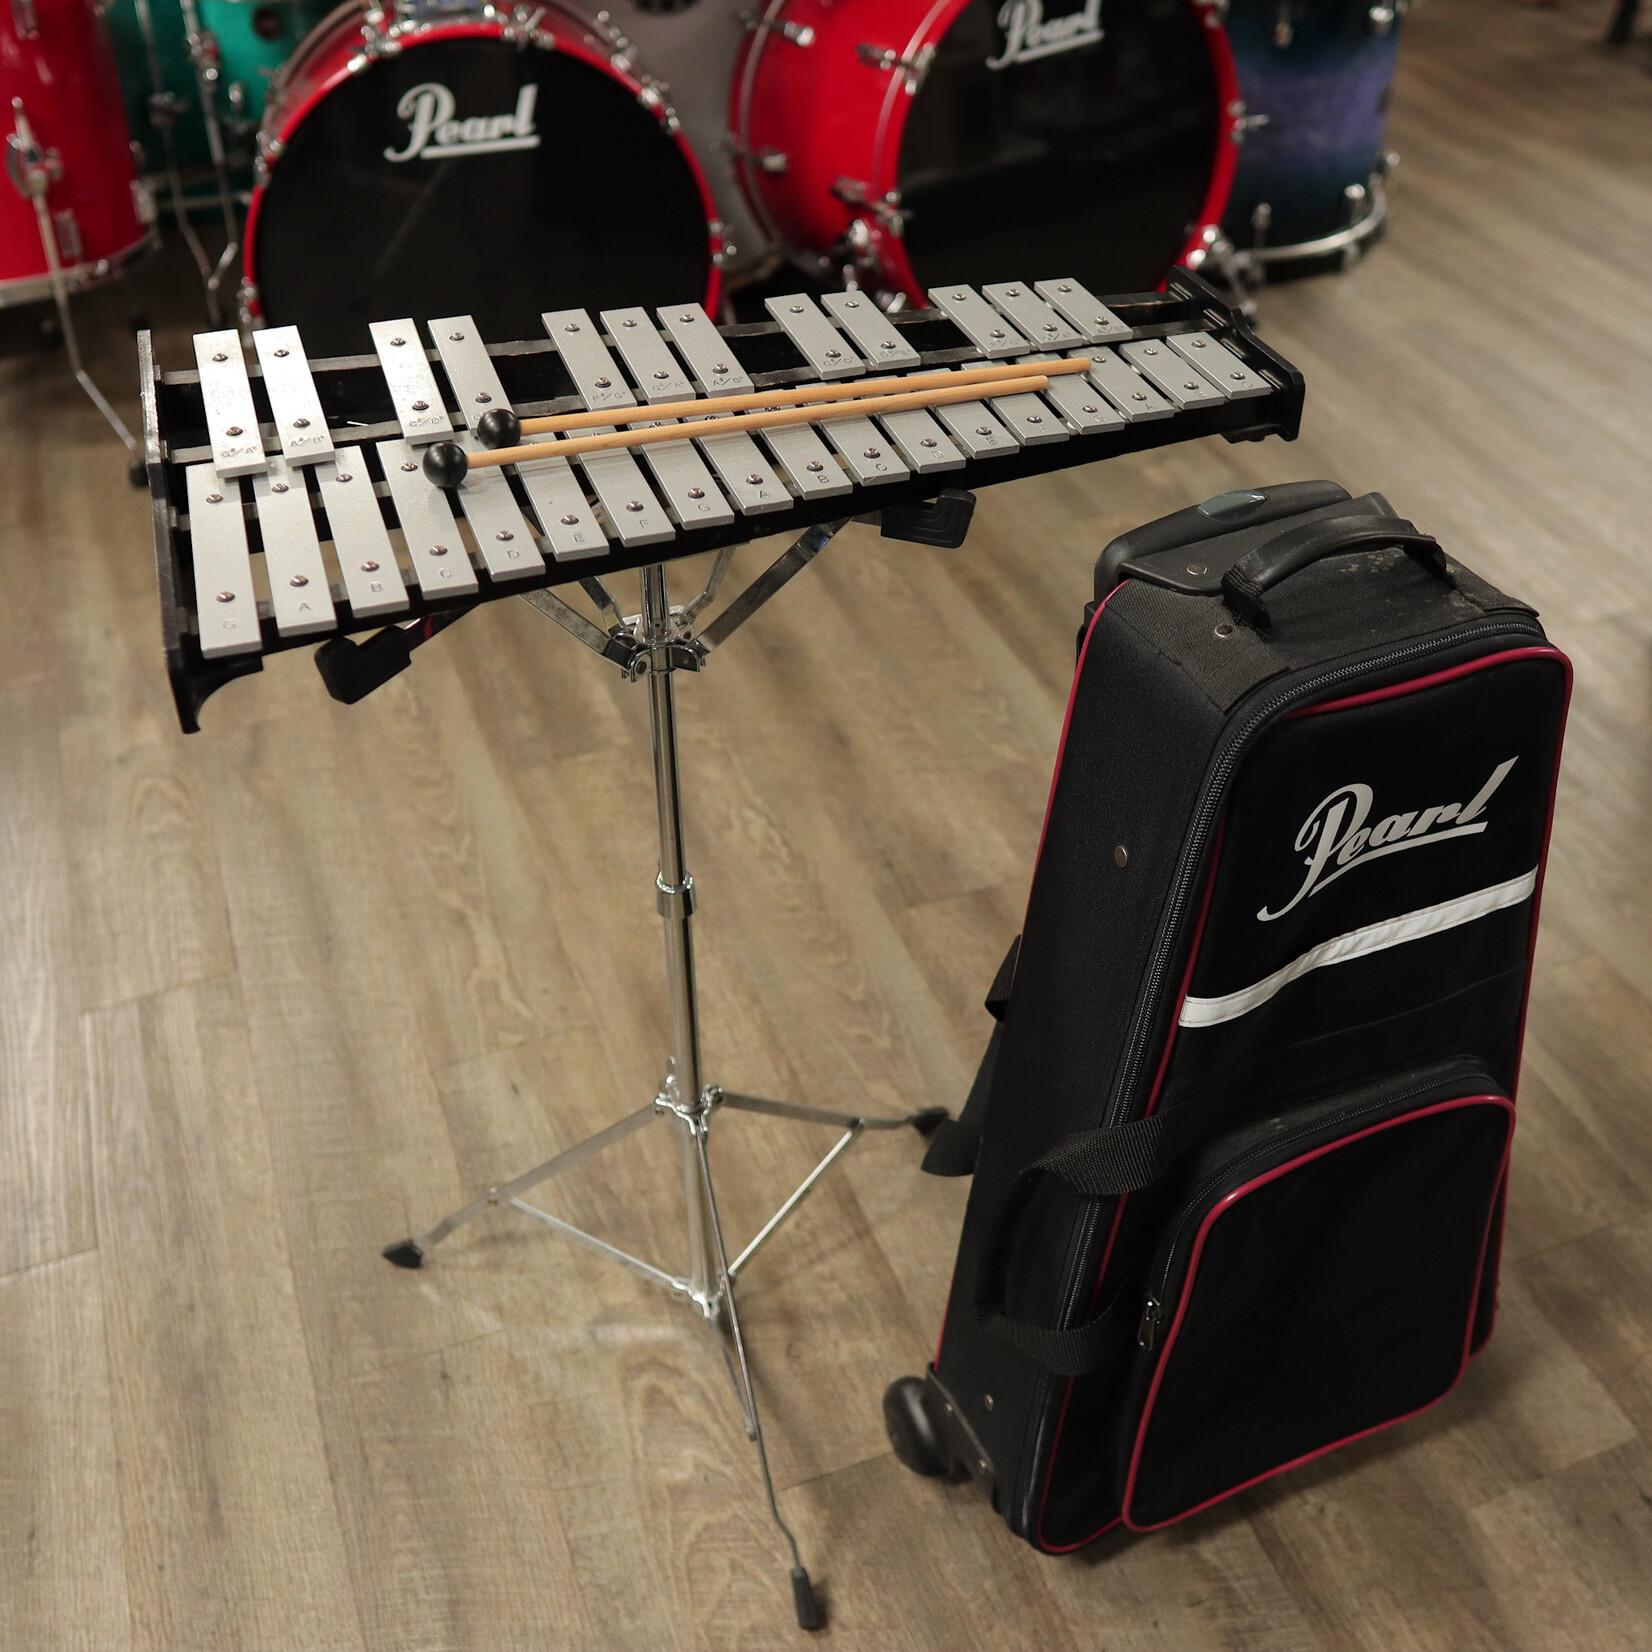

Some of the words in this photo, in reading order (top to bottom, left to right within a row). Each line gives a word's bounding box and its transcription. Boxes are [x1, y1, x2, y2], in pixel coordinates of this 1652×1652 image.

[985, 0, 1105, 71] Pearl
[383, 82, 541, 163] Pearl
[875, 462, 888, 472] C
[817, 474, 830, 485] B
[759, 489, 771, 499] A
[697, 503, 711, 513] G
[638, 518, 649, 529] F
[572, 532, 585, 543] E
[507, 549, 520, 560] D
[370, 581, 383, 593] B
[299, 601, 311, 612] A
[1257, 755, 1519, 922] Pearl
